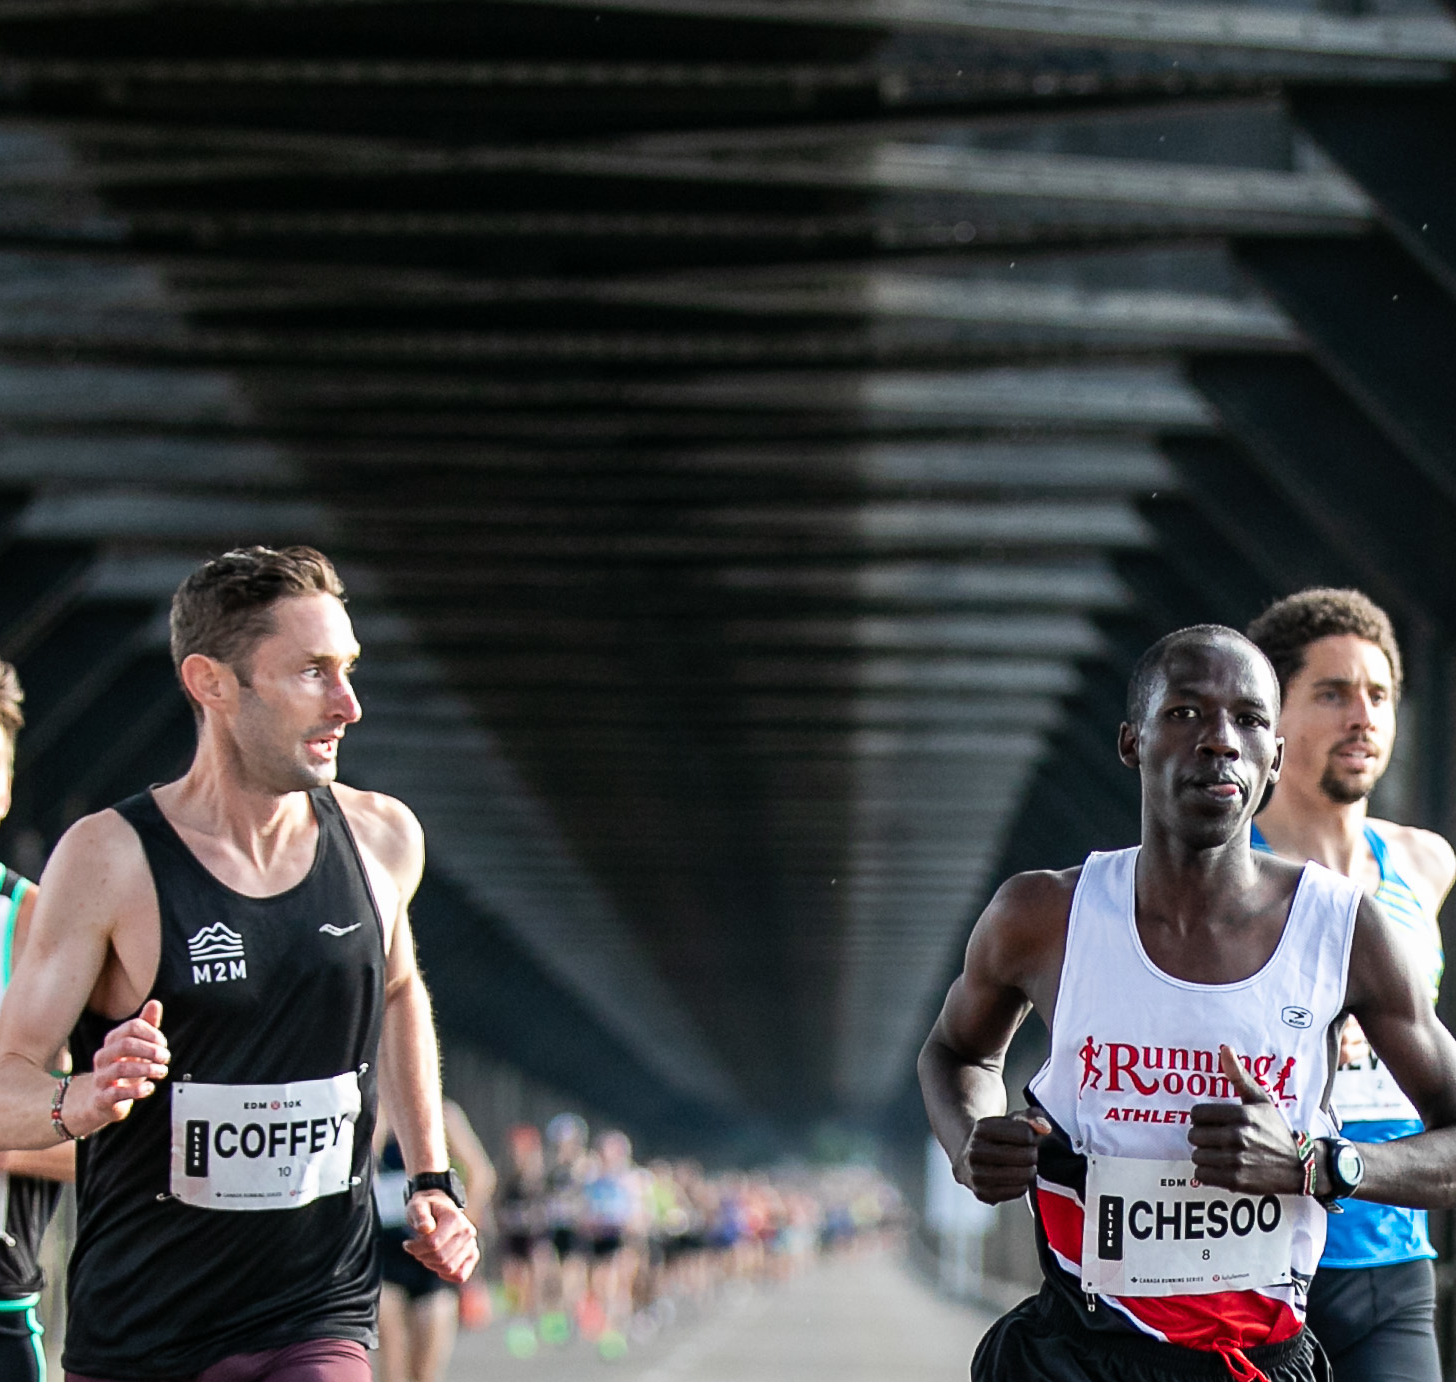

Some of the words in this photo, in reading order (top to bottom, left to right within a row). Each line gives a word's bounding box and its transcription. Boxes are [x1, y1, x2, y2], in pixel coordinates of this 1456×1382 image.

[192, 959, 247, 984] M2M
[243, 1102, 267, 1110] EDM
[283, 1100, 302, 1109] 10K
[1104, 1108, 1191, 1124] ATHLET
[214, 1112, 349, 1159] COFFEY
[277, 1166, 292, 1177] 10
[1160, 1178, 1187, 1187] EDM
[1128, 1194, 1282, 1241] CHESOO
[1106, 1203, 1114, 1247] ELITE
[1201, 1249, 1211, 1261] 8
[1221, 1273, 1250, 1281] lululemon
